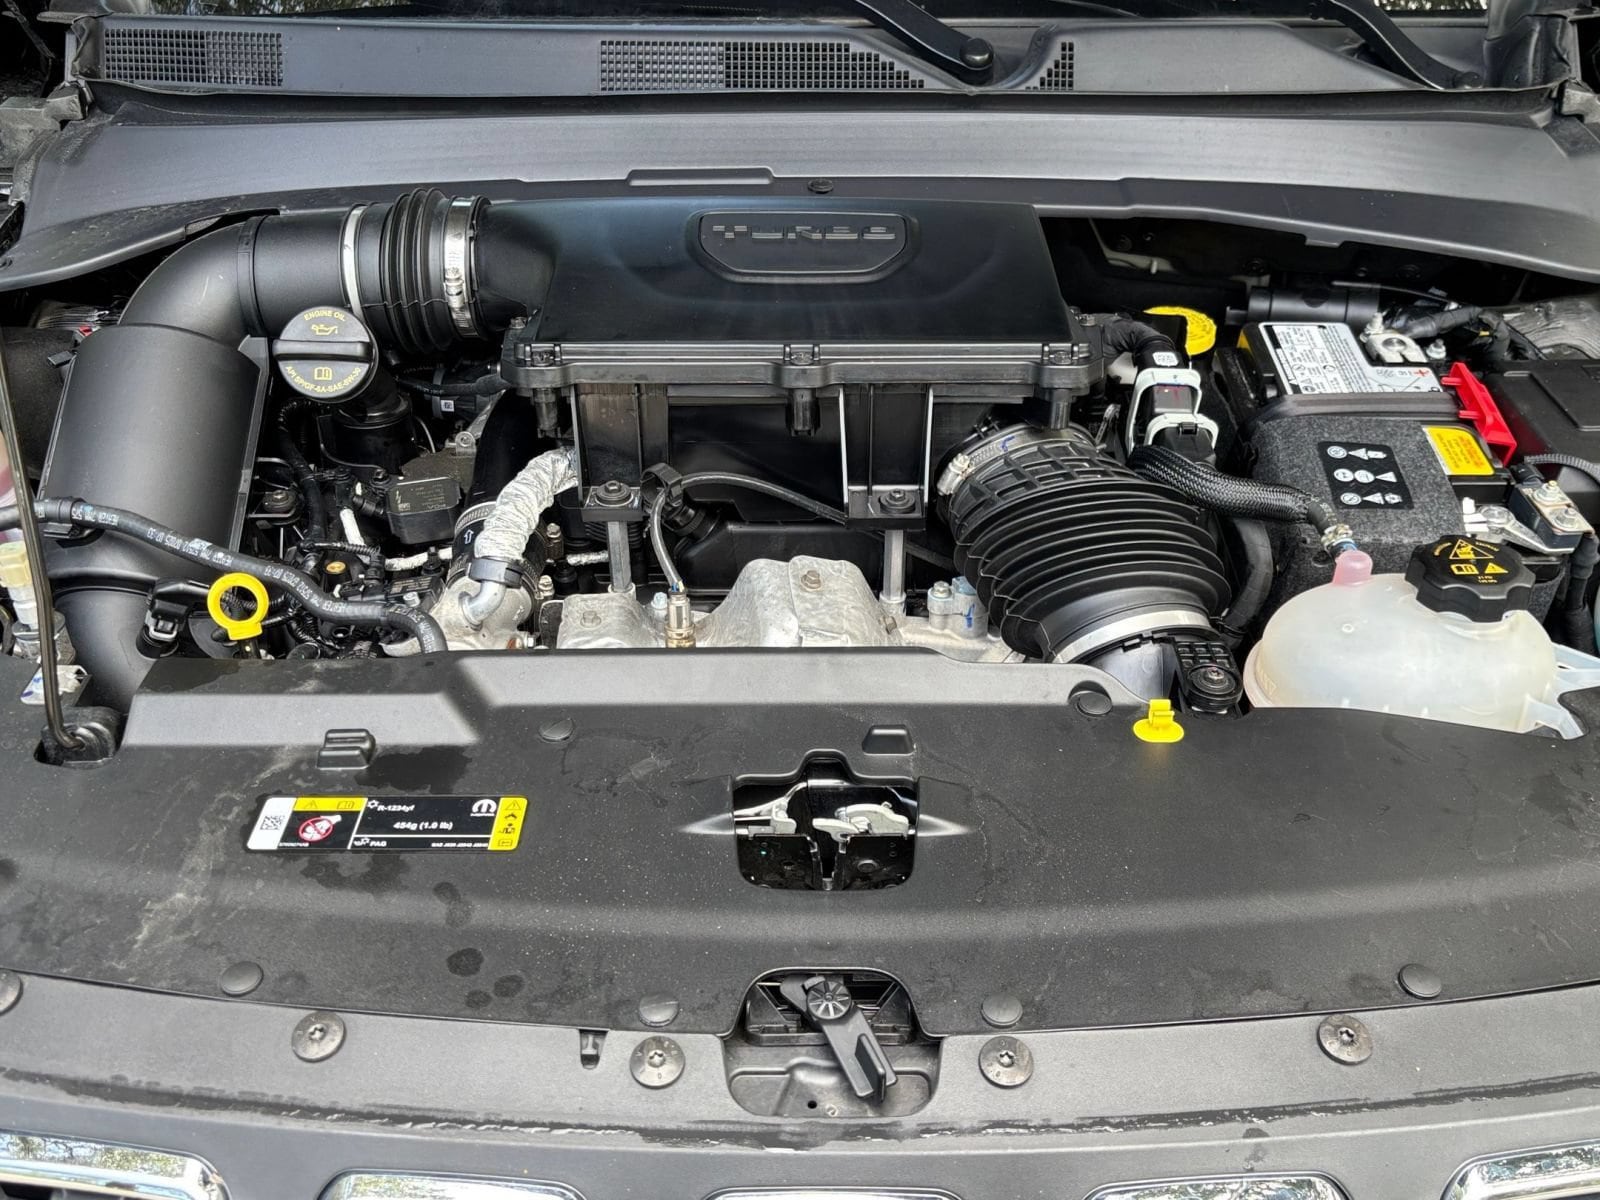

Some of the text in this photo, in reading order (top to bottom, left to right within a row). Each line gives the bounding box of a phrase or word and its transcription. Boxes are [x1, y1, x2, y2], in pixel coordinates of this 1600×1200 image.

[712, 224, 896, 241] TURBO
[303, 310, 346, 322] ENGINE OIL
[285, 366, 297, 379] API
[377, 804, 415, 813] R-1234yf
[393, 821, 454, 831] 454g (1.0 lb)
